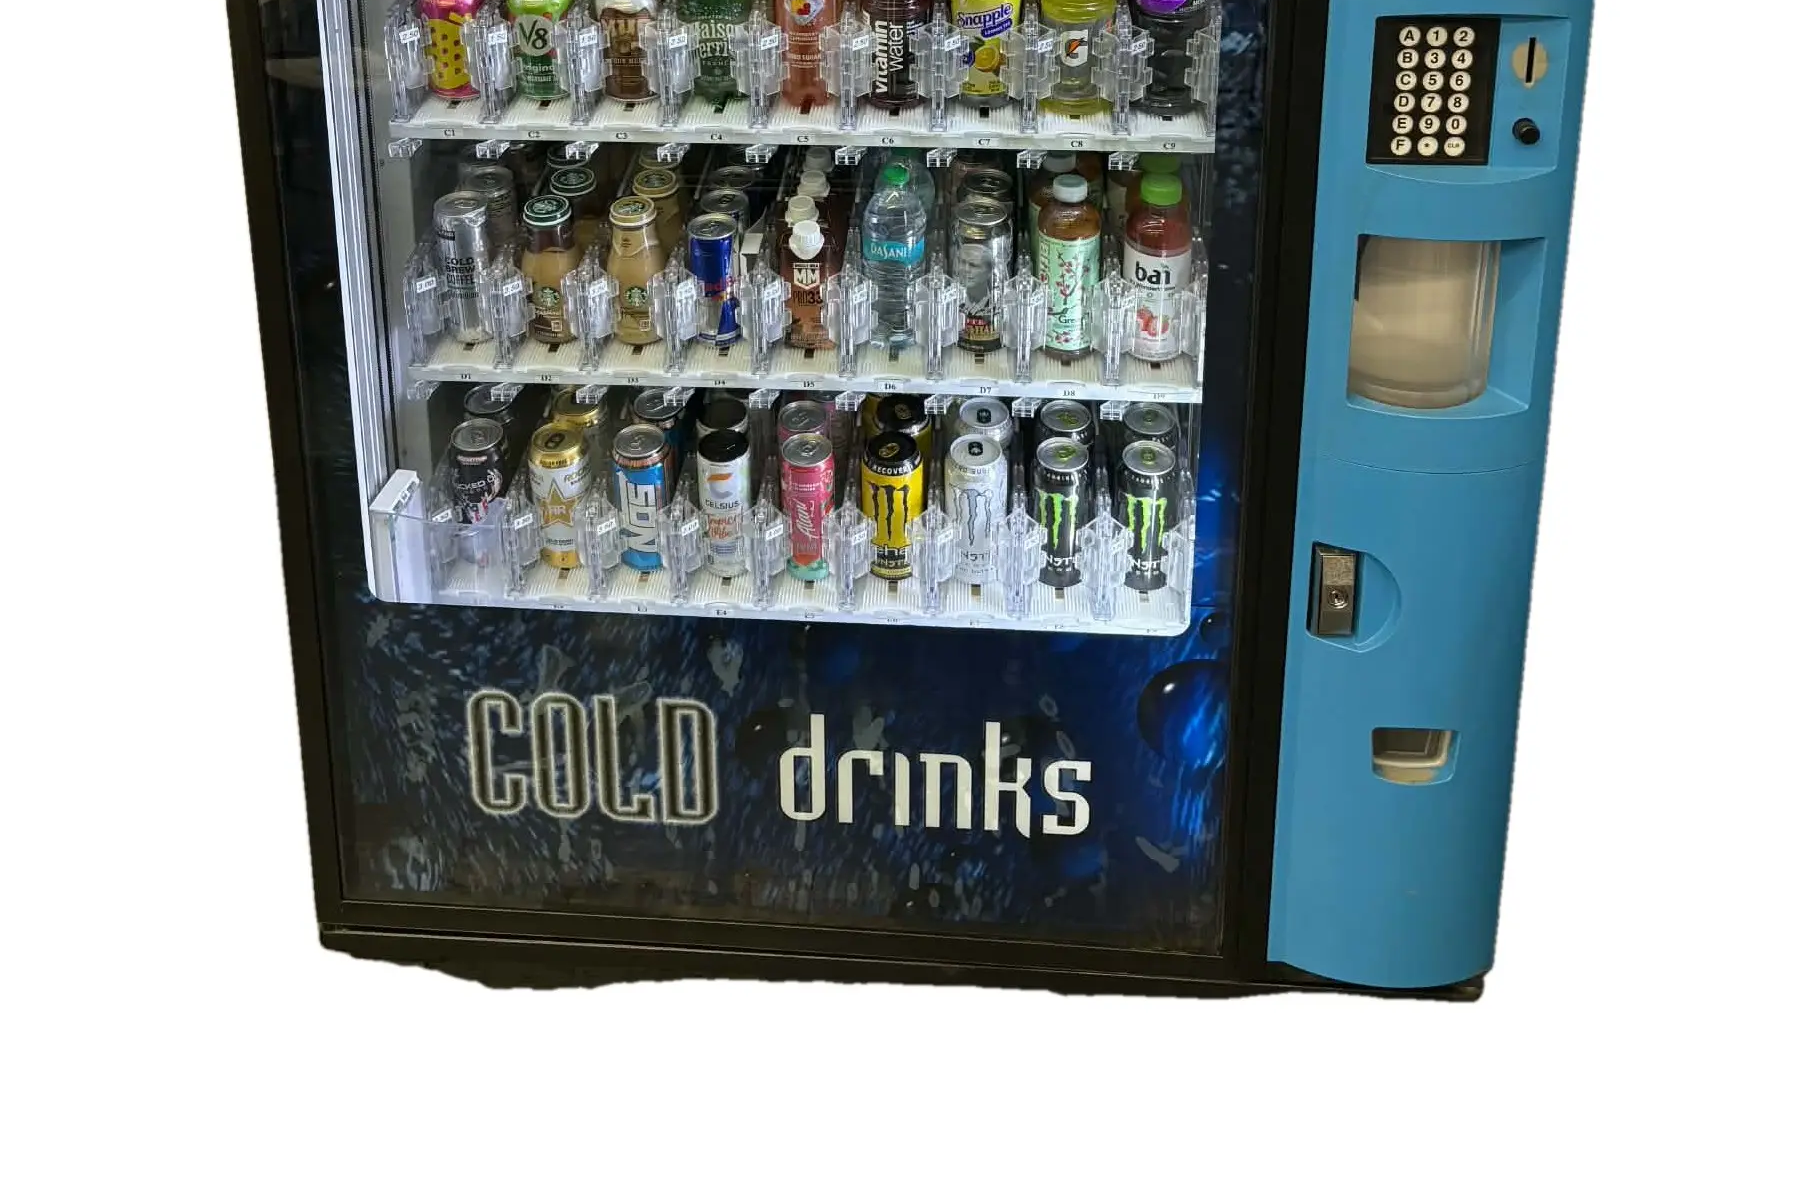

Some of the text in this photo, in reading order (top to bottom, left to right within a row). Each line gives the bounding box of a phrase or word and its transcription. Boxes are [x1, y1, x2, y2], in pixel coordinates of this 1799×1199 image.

[957, 3, 1011, 27] Snapple
[519, 20, 548, 50] V8
[1404, 30, 1469, 42] A 1 2
[1403, 52, 1466, 64] B 3 4
[1401, 74, 1464, 86] C 5 6
[1399, 96, 1462, 108] D 7 8
[1397, 118, 1460, 130] E 9 0
[1396, 139, 1406, 151] F
[705, 499, 741, 510] CELSIUS
[466, 690, 1092, 838] COLD drinks
